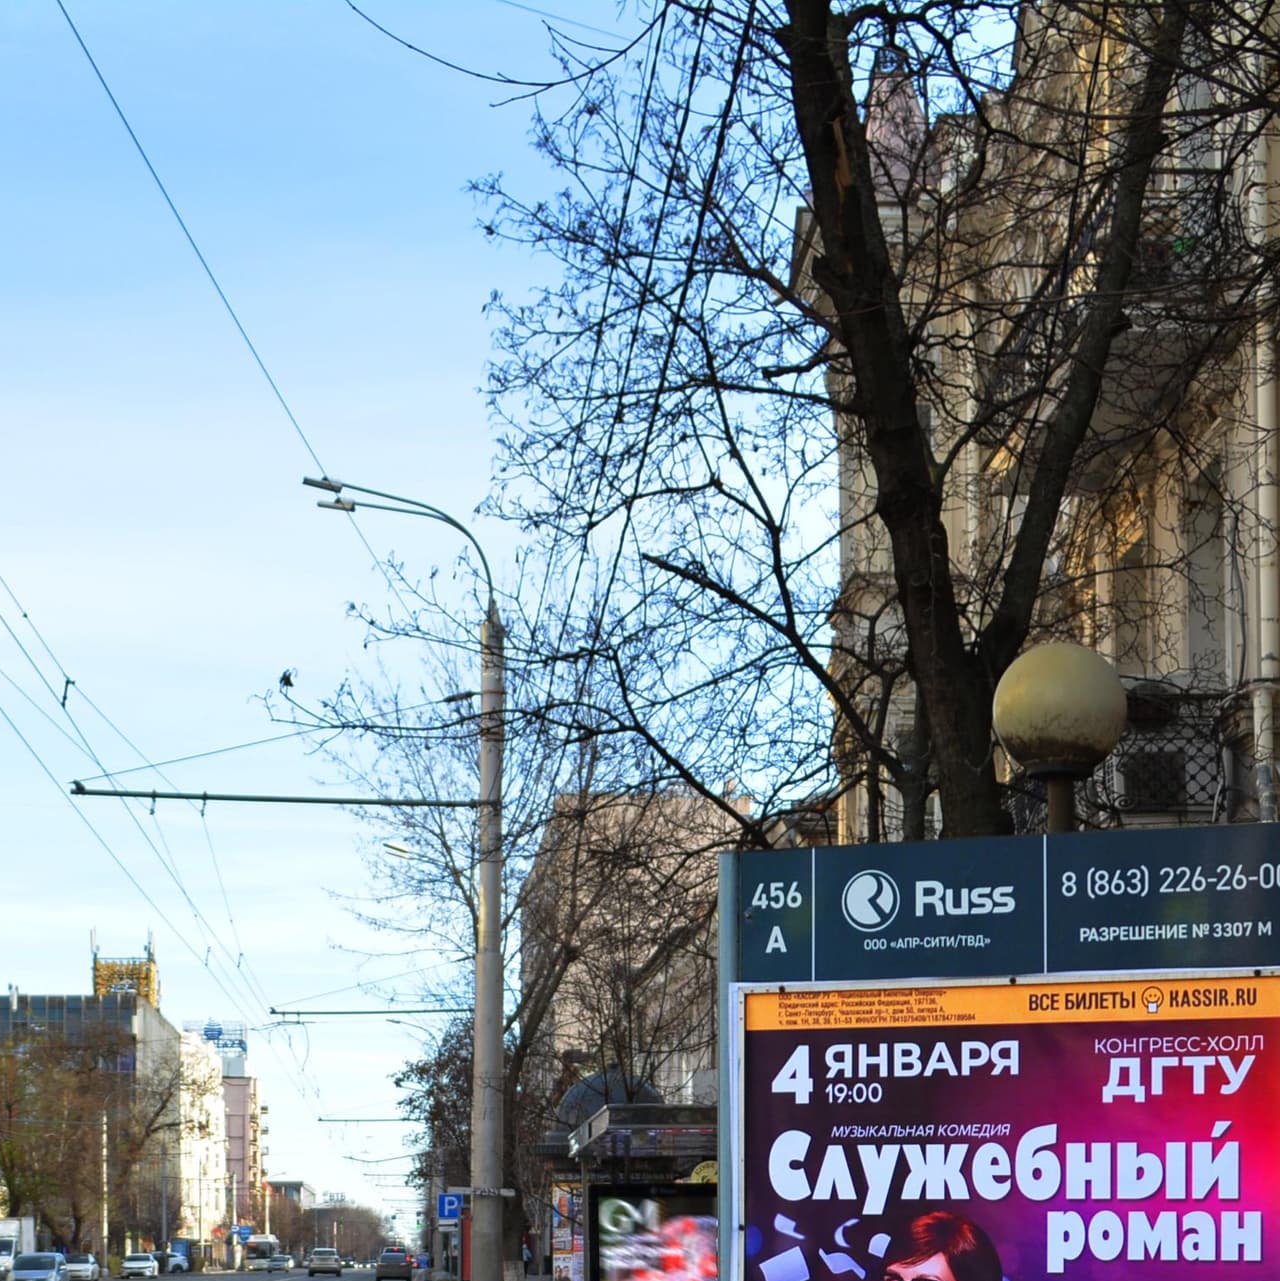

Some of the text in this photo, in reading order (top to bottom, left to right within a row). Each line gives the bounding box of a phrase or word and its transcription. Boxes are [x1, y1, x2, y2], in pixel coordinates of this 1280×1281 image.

[1062, 873, 1076, 897] 8
[1087, 865, 1149, 899] (863)
[752, 882, 802, 910] 456
[916, 880, 1015, 917] Russ
[863, 934, 991, 950] ООО «АПР-СИТИ/ТВД»
[1079, 924, 1186, 943] РАЗРЕШЕНИЕ
[1213, 922, 1252, 939] 3307
[1029, 990, 1136, 1011] ВСЕ БИЛЕТЫ
[1168, 988, 1258, 1008] KASSIR.RU
[1095, 1035, 1264, 1055] КОНГРЕСС-ХОЛЛ
[771, 1041, 1019, 1104] 4 ЯНВАРЯ
[1102, 1056, 1256, 1104] ДГТУ
[826, 1083, 882, 1104] 19:00
[831, 1122, 1010, 1138] МУЗЫКАЛЬНАЯ КОМЕДИЯ
[768, 1120, 1240, 1216] Служебный
[444, 1196, 458, 1216] P
[1047, 1210, 1262, 1273] роман
